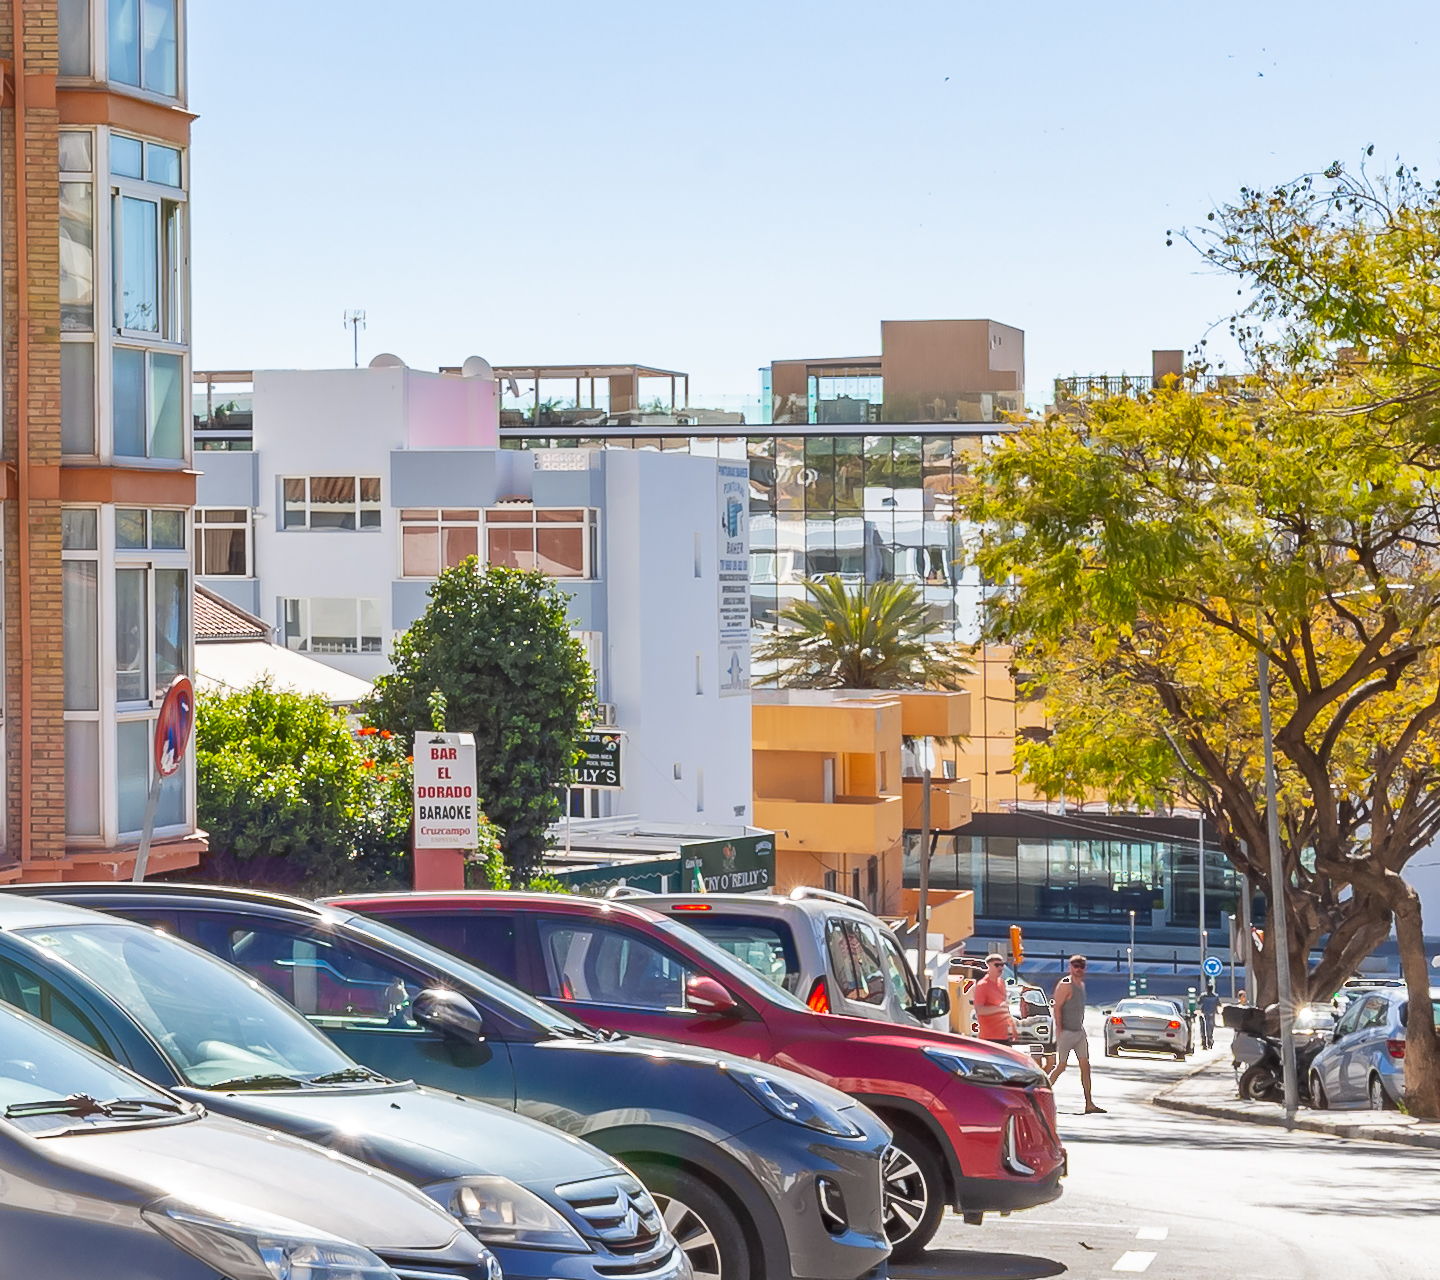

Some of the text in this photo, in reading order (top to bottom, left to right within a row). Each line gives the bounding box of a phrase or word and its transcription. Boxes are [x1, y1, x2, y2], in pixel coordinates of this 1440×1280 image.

[430, 748, 457, 760] BAR
[437, 767, 452, 779] EL
[418, 786, 472, 798] DORADO
[419, 805, 472, 820] BARAOKE
[420, 826, 471, 837] Cruzcampo
[691, 875, 720, 893] RCKY
